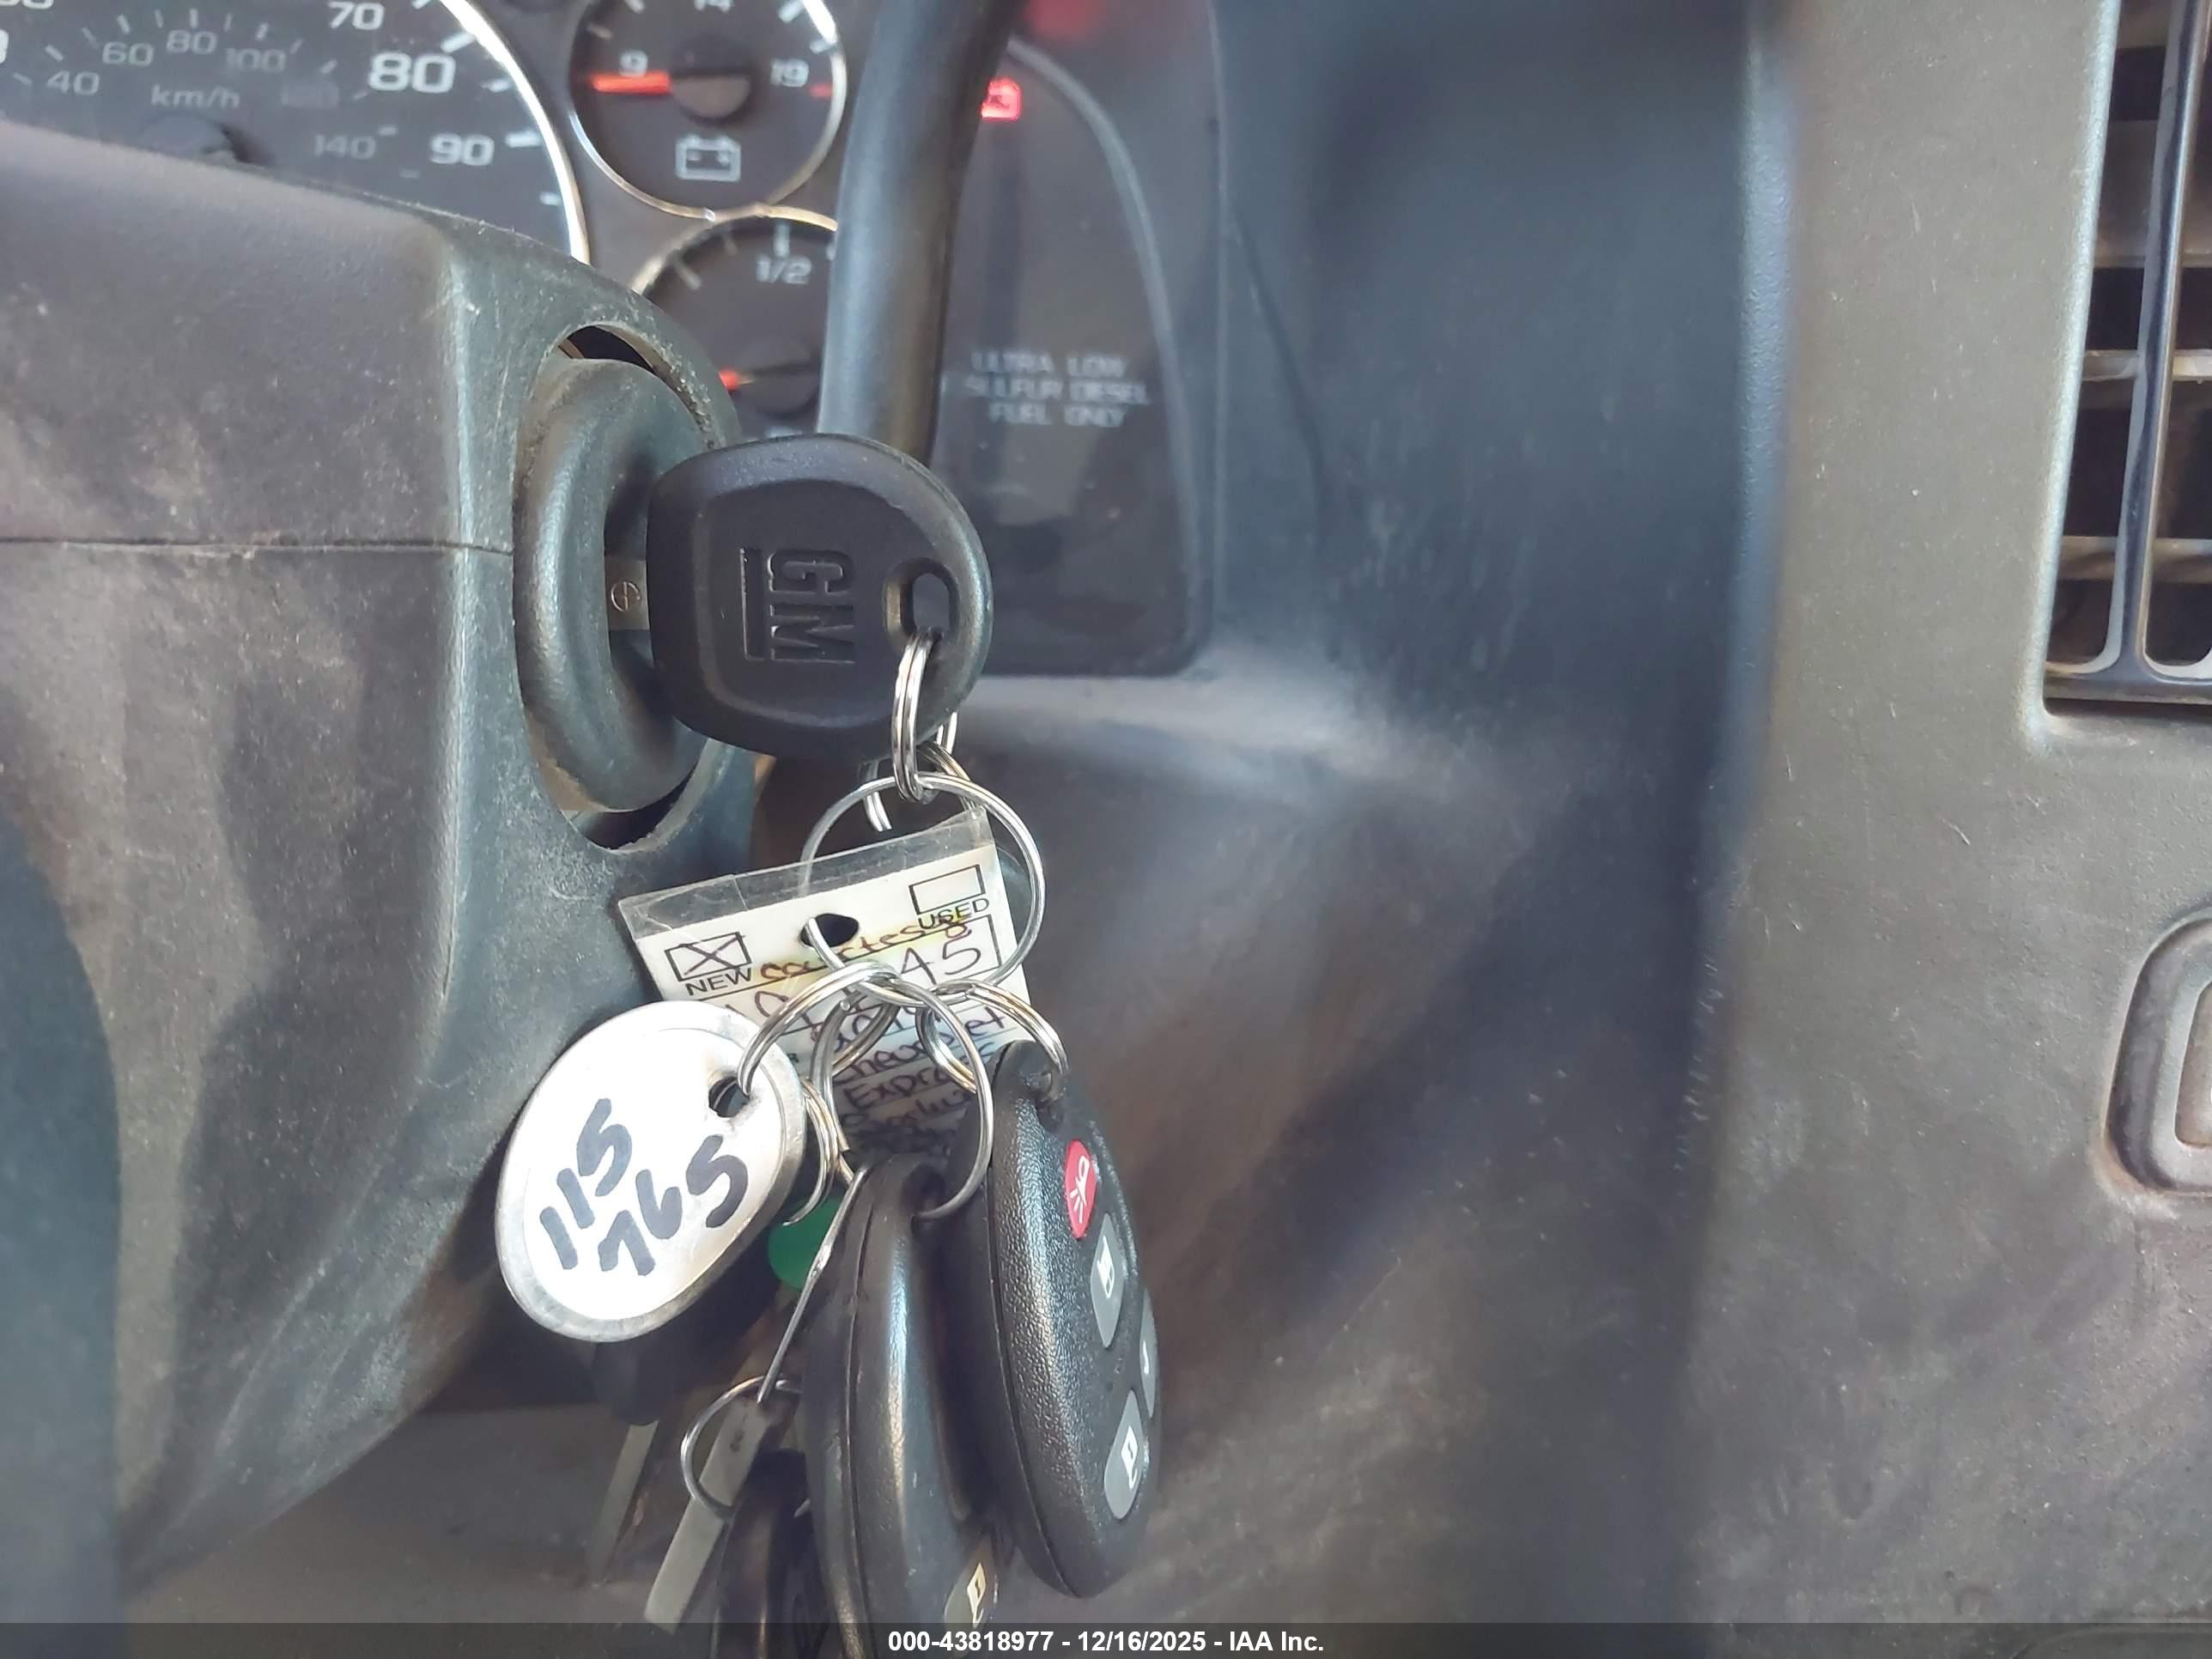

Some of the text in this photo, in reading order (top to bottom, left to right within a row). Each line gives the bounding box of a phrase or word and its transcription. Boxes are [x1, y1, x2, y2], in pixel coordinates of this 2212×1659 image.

[328, 2, 385, 31] 70
[102, 41, 155, 67] 60
[167, 29, 216, 56] 80
[225, 48, 287, 74] 100
[368, 52, 457, 94] 80
[46, 70, 100, 96] 40
[151, 83, 241, 110] km/h
[430, 132, 495, 167] 90
[756, 255, 812, 285] 1/2
[768, 550, 855, 665] GM
[917, 897, 990, 930] USED
[684, 968, 752, 997] NEW
[539, 1097, 633, 1270] 115
[597, 1134, 749, 1276] 765
